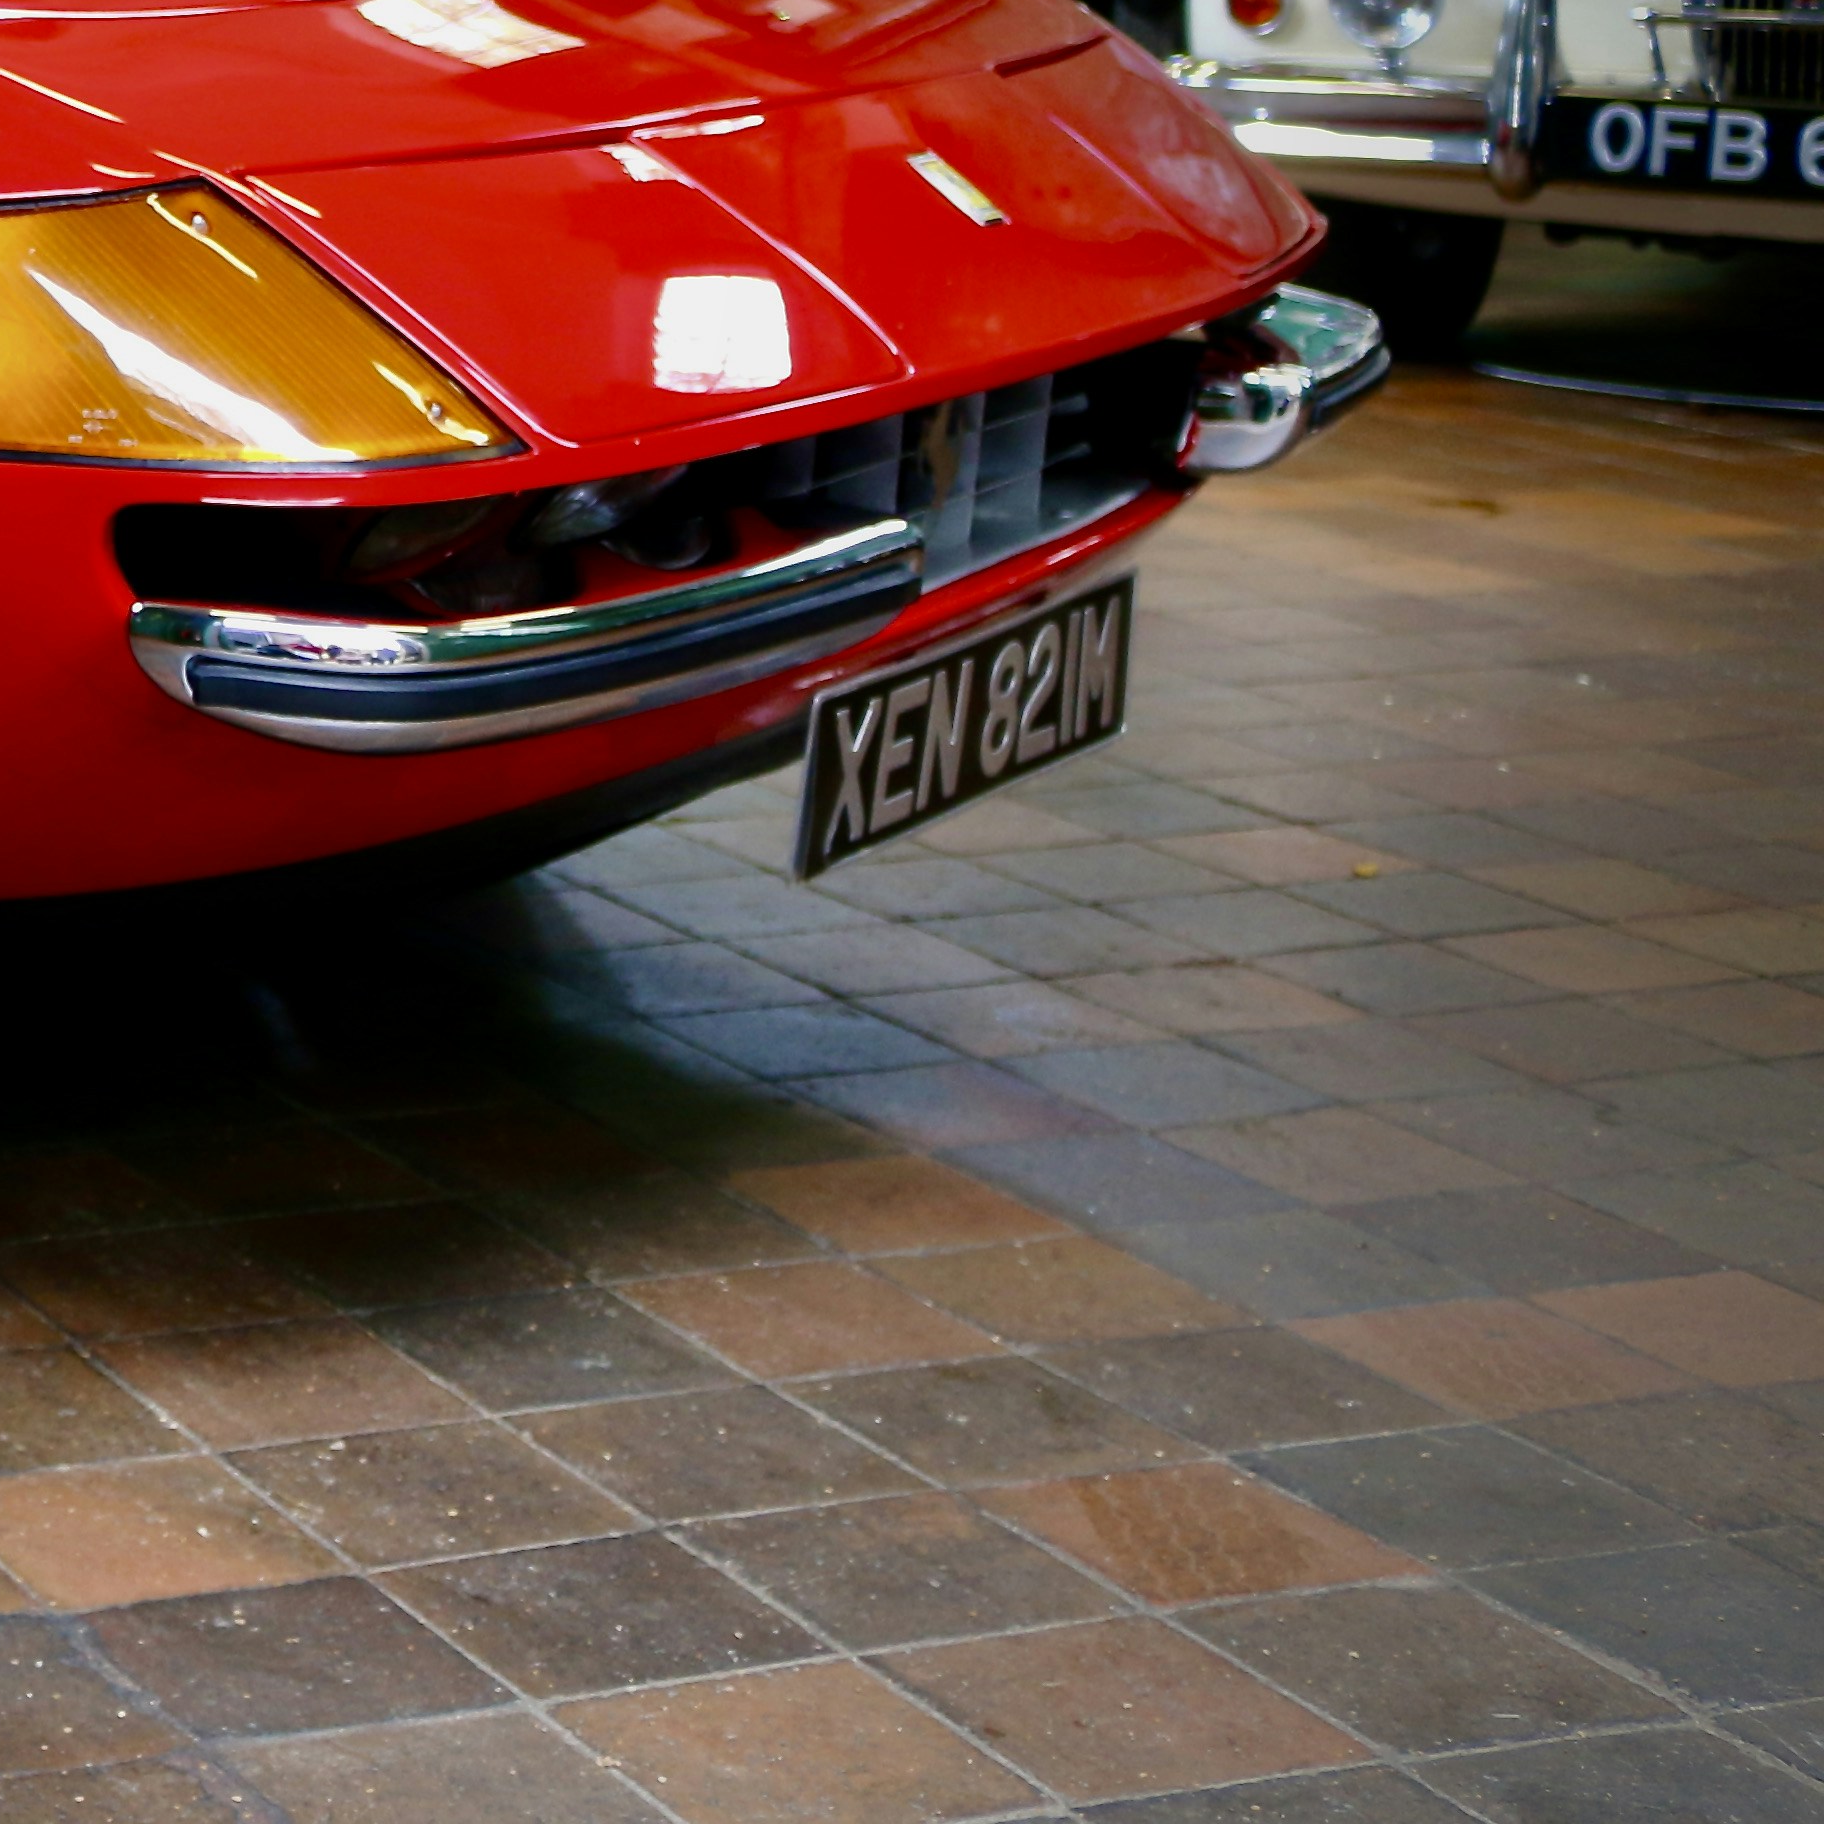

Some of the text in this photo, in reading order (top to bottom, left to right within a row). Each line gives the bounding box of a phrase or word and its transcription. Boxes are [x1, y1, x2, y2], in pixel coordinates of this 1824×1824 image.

[1590, 102, 1768, 182] OFB
[823, 594, 1121, 855] XEN 821M
